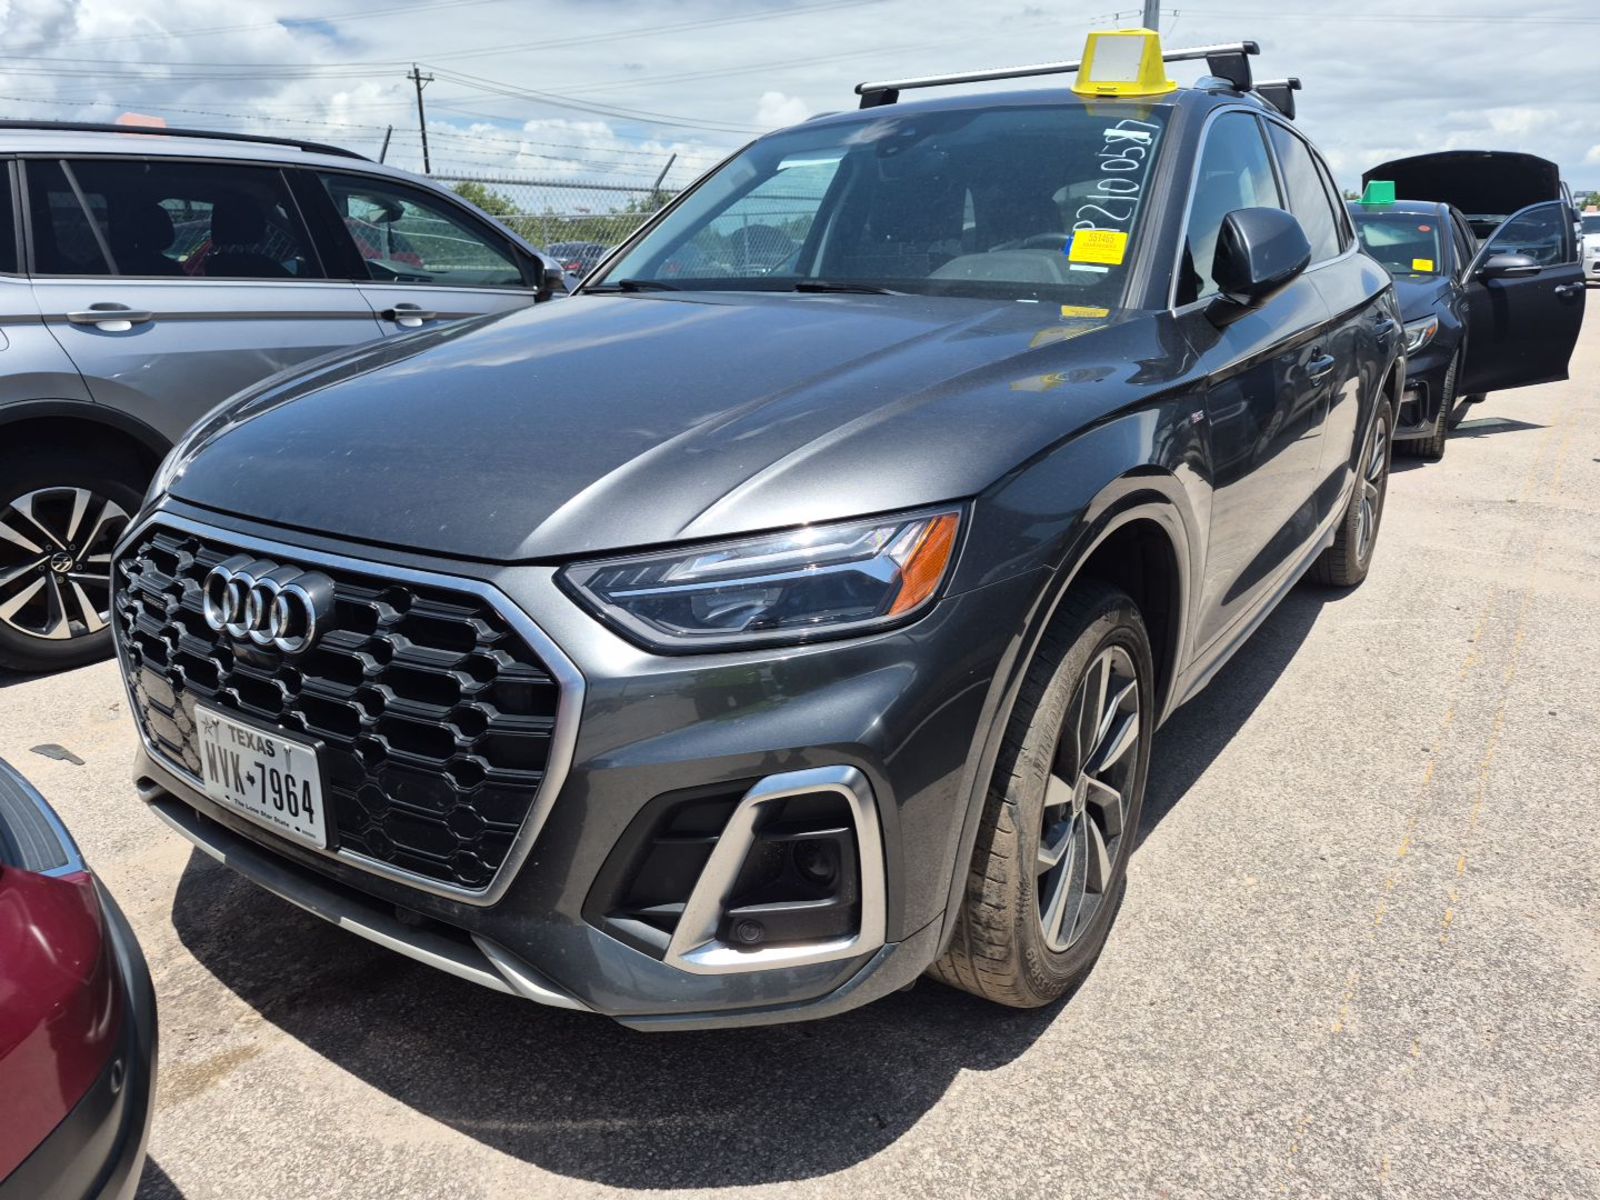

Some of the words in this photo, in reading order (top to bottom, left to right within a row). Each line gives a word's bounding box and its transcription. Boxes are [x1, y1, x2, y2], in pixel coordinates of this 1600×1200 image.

[227, 724, 275, 758] TEXAS
[204, 739, 246, 796] WVK
[254, 761, 314, 824] 7964
[234, 799, 245, 807] The
[246, 804, 259, 813] Lone
[260, 810, 272, 819] Star
[274, 816, 289, 827] State
